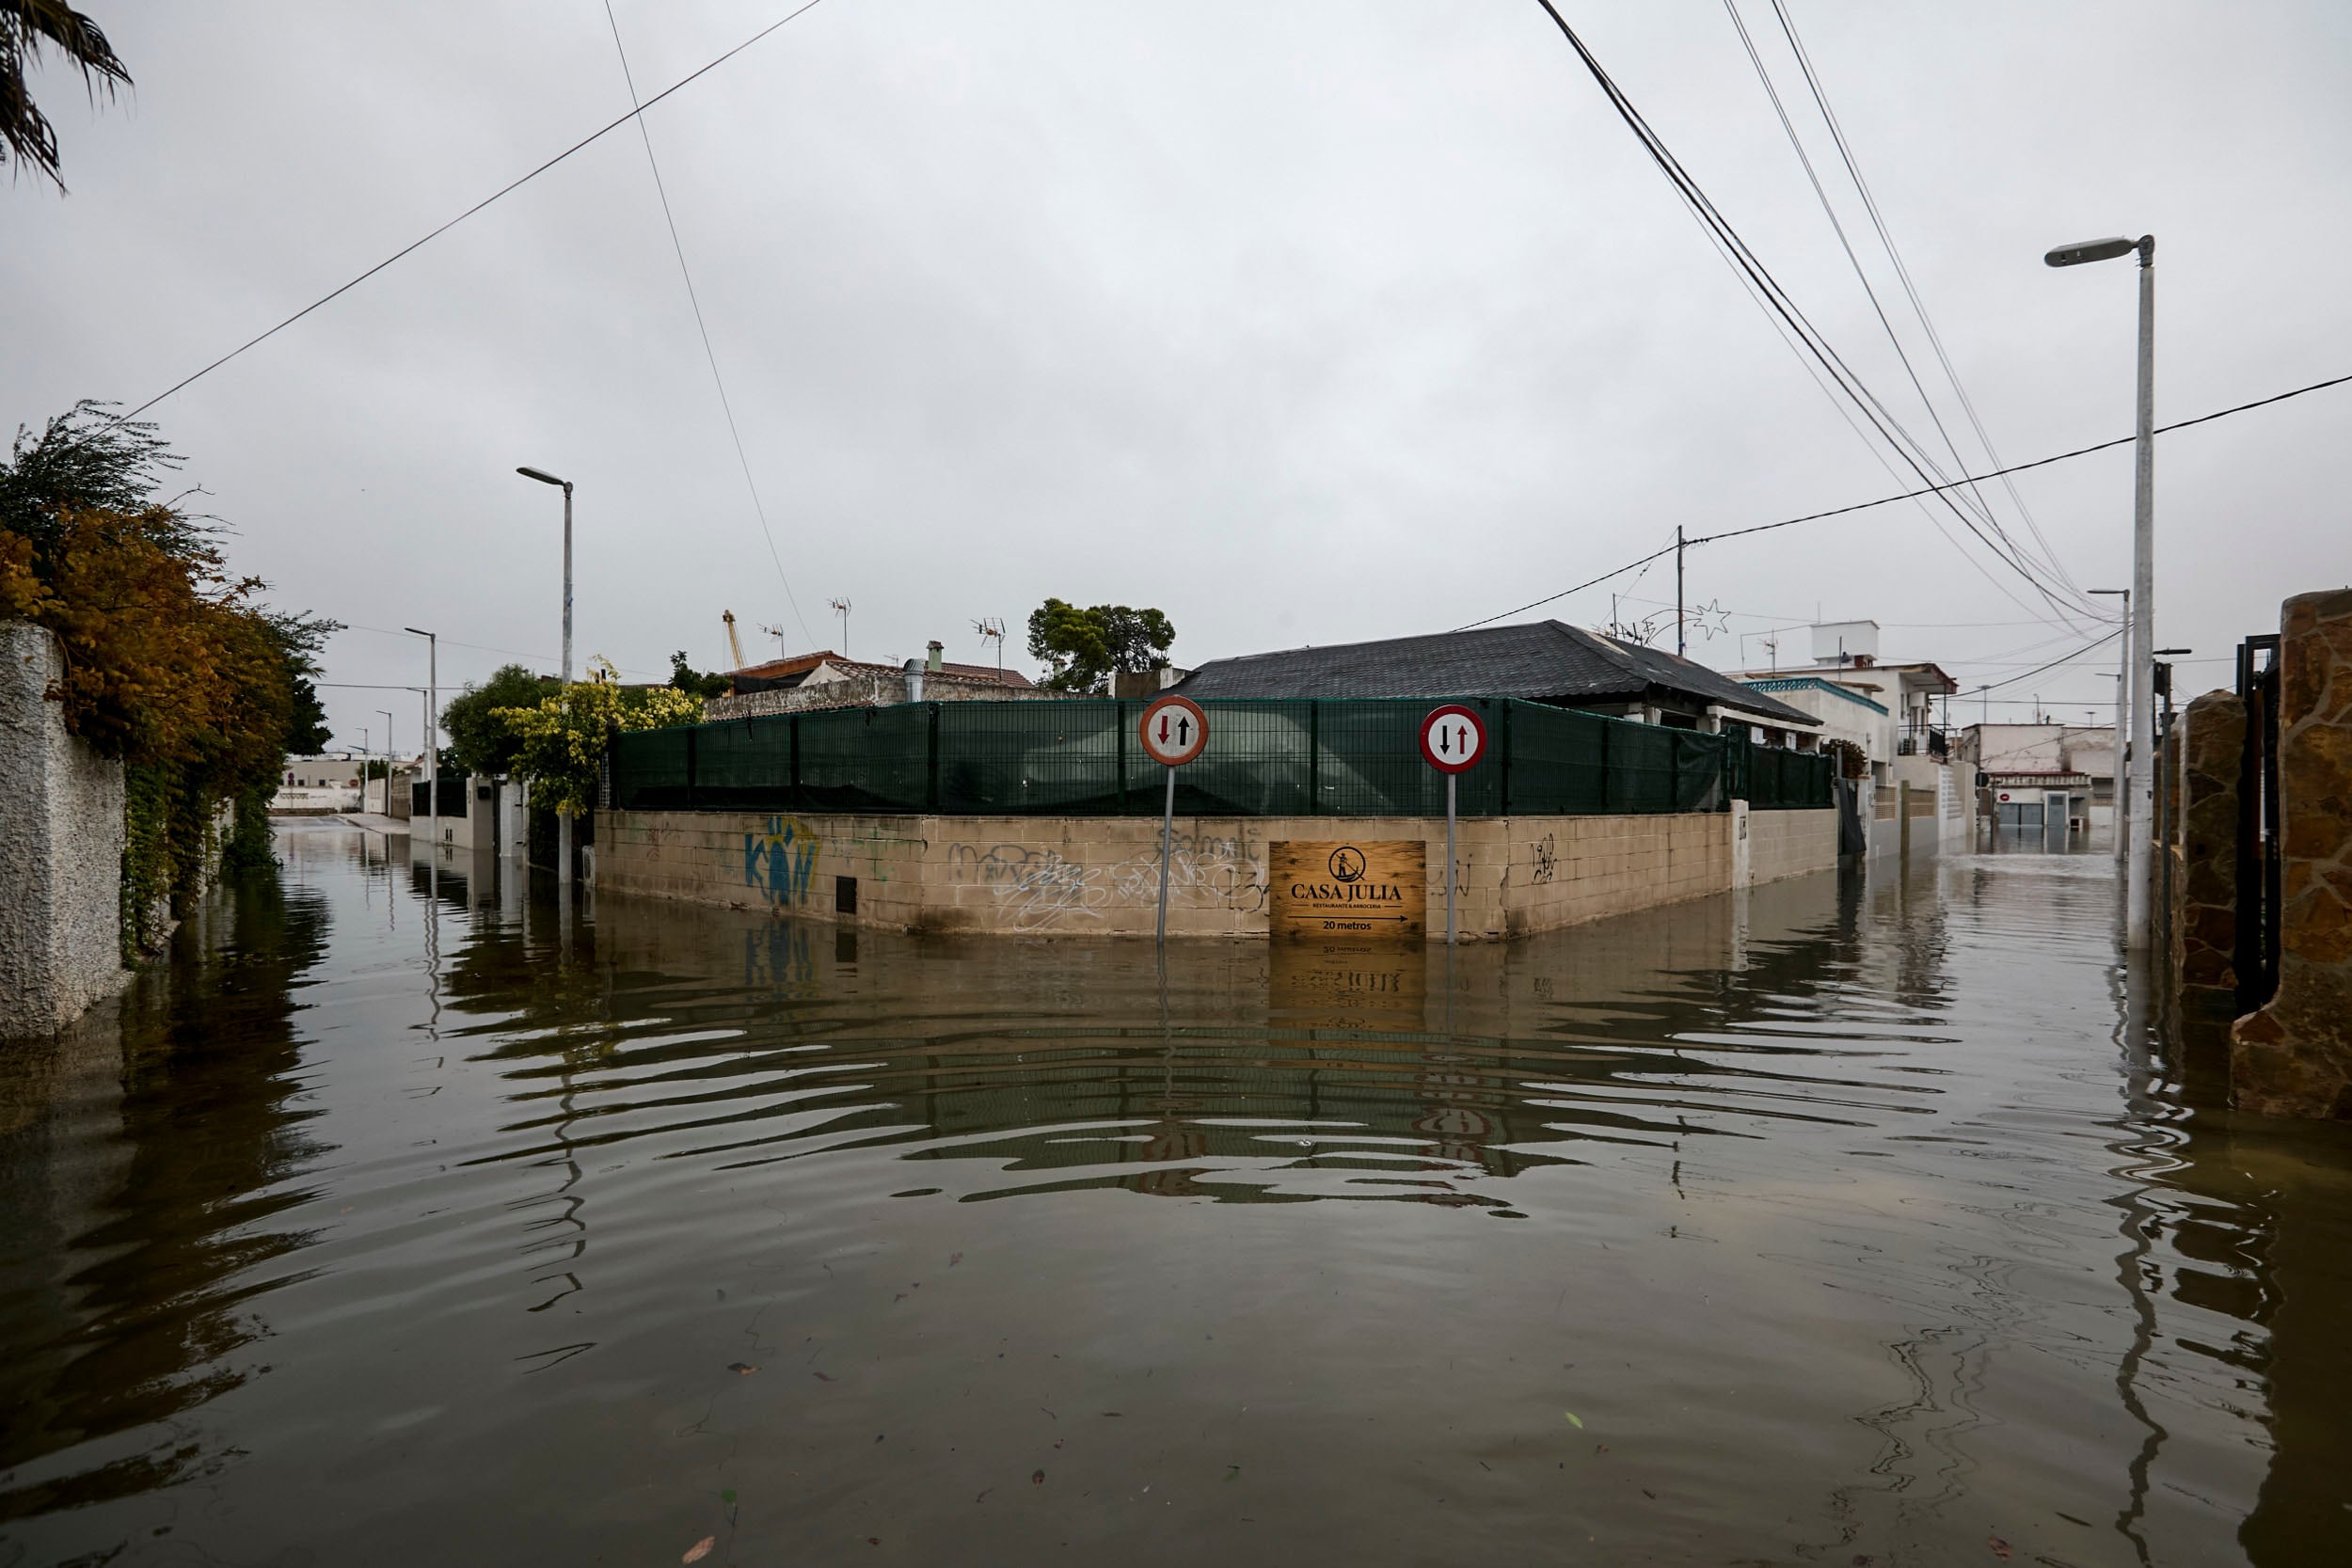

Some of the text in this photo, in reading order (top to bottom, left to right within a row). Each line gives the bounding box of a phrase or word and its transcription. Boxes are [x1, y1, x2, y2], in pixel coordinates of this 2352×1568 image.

[1291, 883, 1402, 902] CASA JULIA
[1323, 921, 1372, 930] 20 metros
